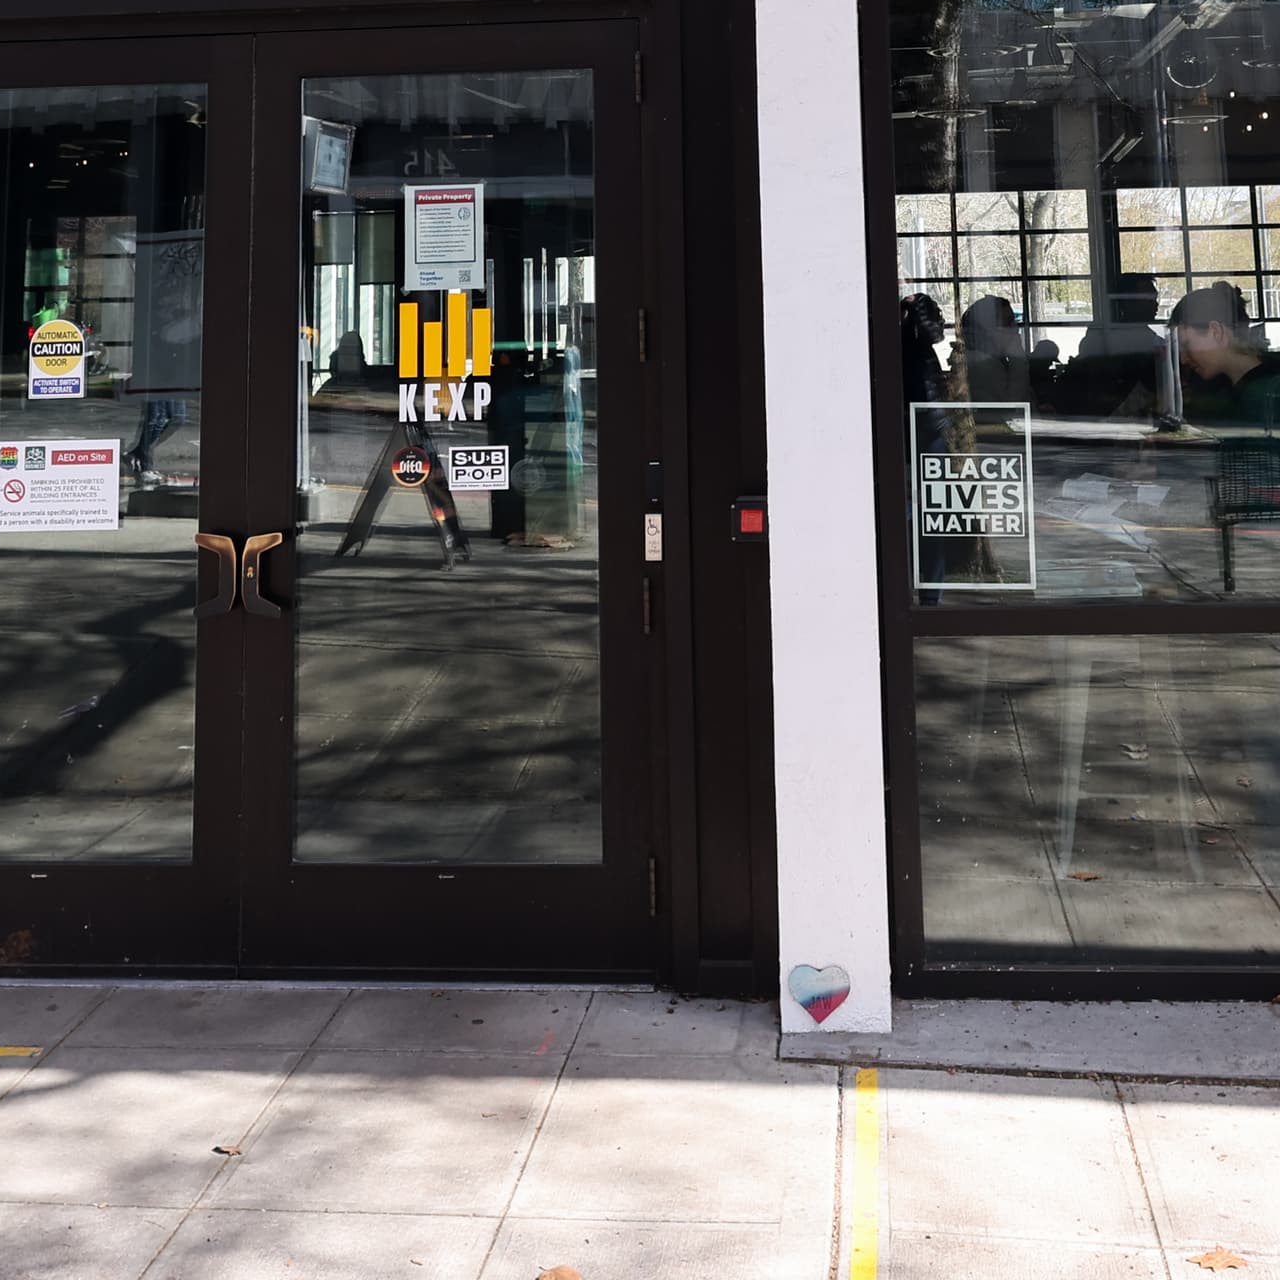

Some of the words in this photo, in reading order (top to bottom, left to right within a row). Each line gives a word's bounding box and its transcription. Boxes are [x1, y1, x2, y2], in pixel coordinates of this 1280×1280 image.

[443, 193, 472, 201] Property
[36, 331, 78, 340] AUTOMATIC
[34, 343, 80, 355] CAUTION
[45, 358, 67, 367] DOOR
[33, 379, 58, 387] ACTIVATE
[48, 385, 73, 394] OPERATE
[399, 382, 491, 422] KEXP
[57, 454, 75, 462] AED
[90, 453, 107, 461] Site
[924, 457, 1019, 480] BLACK
[925, 484, 1020, 510] LIVES
[47, 509, 78, 517] specifically
[49, 518, 74, 526] disability
[926, 513, 1021, 533] MATTER
